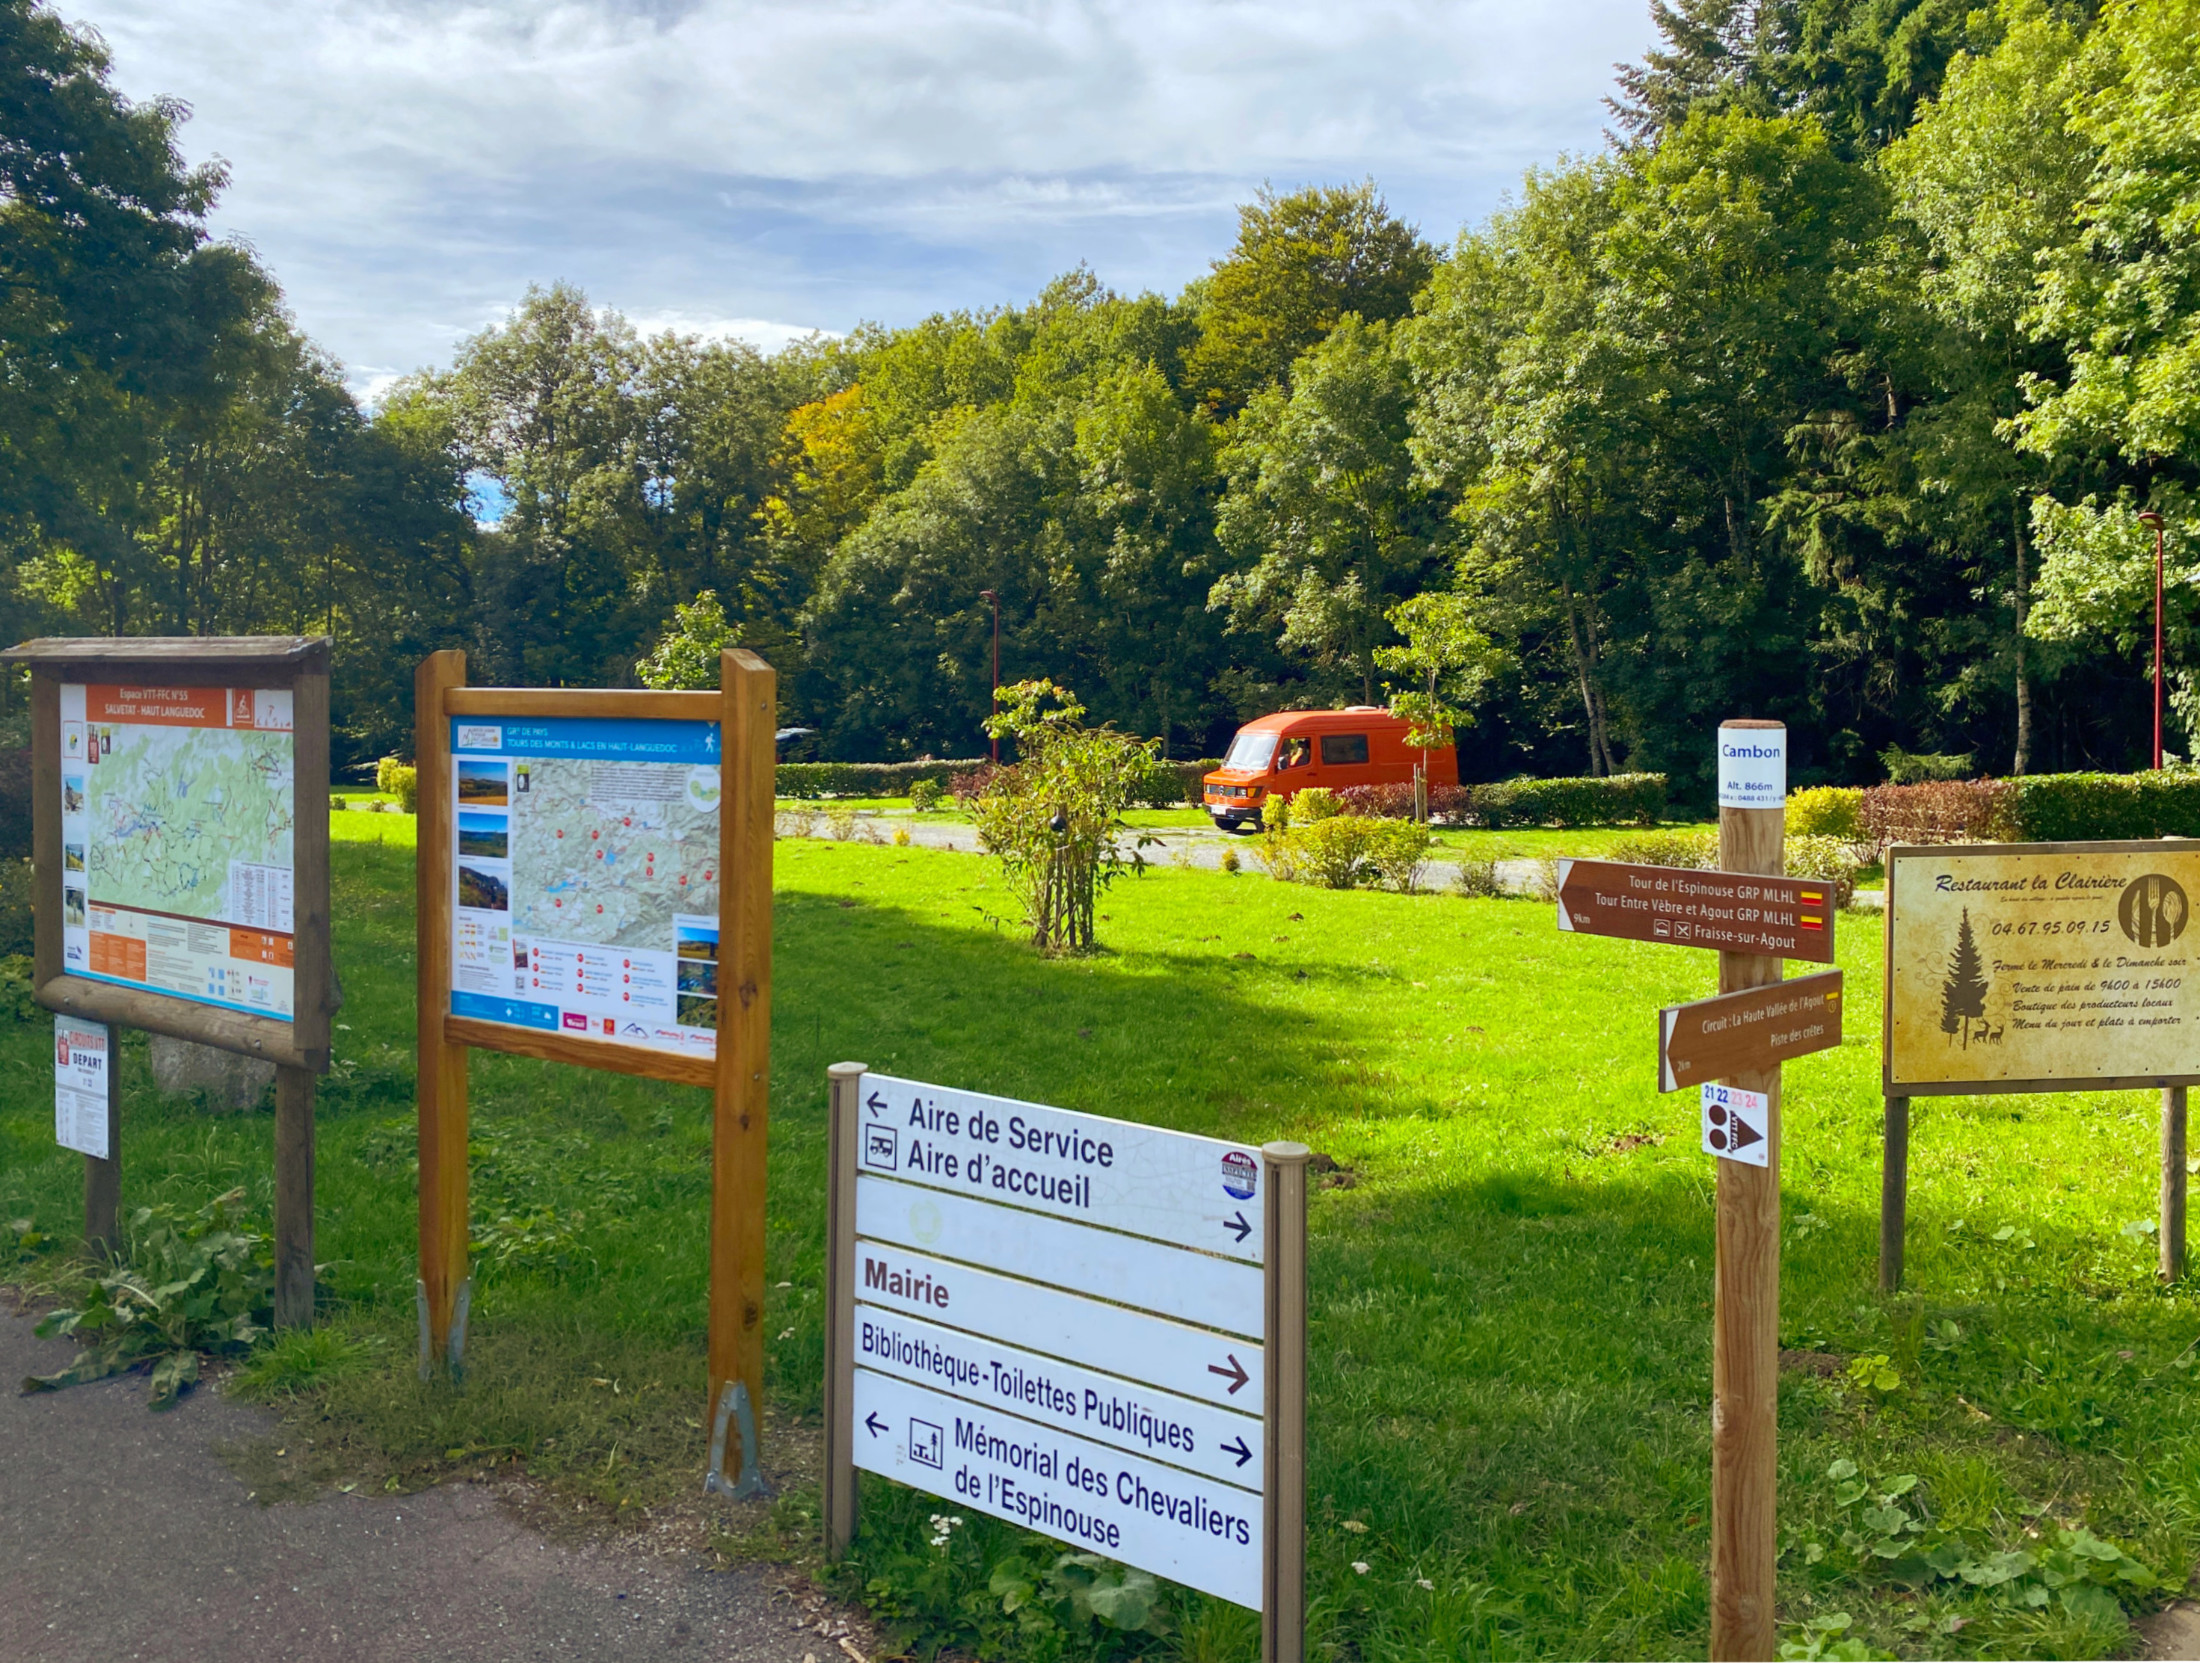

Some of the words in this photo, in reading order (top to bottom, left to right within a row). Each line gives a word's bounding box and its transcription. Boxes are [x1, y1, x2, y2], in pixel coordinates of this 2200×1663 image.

[120, 688, 142, 701] Espace
[143, 688, 171, 700] VTT-FFC
[105, 703, 136, 715] SALVETAT
[141, 705, 160, 717] HAUT
[160, 706, 205, 719] LANGUEDOC
[522, 727, 532, 736] DE
[533, 727, 548, 736] PAYS
[507, 738, 529, 748] TOURS
[530, 739, 543, 748] DES
[545, 740, 569, 749] MONTS
[577, 741, 595, 750] LACS
[597, 741, 607, 750] EN
[608, 742, 678, 753] HAUT-LANGUEDOC
[1723, 744, 1780, 758] Cambon
[1727, 781, 1742, 790] Alt.
[1745, 782, 1773, 791] 866m
[1629, 875, 1652, 889] Tour
[1655, 878, 1668, 891] de
[1671, 879, 1734, 898] l'Espinouse
[1737, 886, 1760, 900] GRP
[1763, 888, 1796, 904] MLHL
[1935, 874, 2028, 892] Restaurant
[2031, 875, 2048, 891] la
[2055, 871, 2127, 890] Clairière
[1595, 892, 1618, 906] Tour
[1621, 895, 1649, 910] Entre
[1651, 898, 1683, 914] Vèbre
[1685, 904, 1697, 915] et
[1700, 904, 1734, 920] Agout
[1737, 908, 1760, 922] GRP
[1763, 910, 1796, 926] MLHL
[1573, 913, 1590, 924] 9km
[1695, 924, 1796, 949] Fraisse-sur-Agout
[1992, 920, 2111, 936] 04.67.95.09.15
[1992, 959, 2025, 973] Fermé
[2027, 959, 2037, 970] le
[2042, 958, 2088, 970] Mercredi
[2091, 958, 2099, 968] &
[2103, 958, 2112, 968] le
[2117, 956, 2165, 968] Dimanche
[2168, 957, 2186, 967] soir
[2012, 982, 2040, 993] Vente
[2044, 982, 2055, 992] de
[2057, 982, 2080, 994] pain
[2084, 982, 2095, 991] de
[2100, 980, 2130, 991] 9h00
[2133, 981, 2139, 990] à
[2145, 978, 2181, 989] 15h00
[1702, 1016, 1728, 1034] Circuit
[1732, 1013, 1742, 1026] La
[1743, 1009, 1765, 1024] Haute
[1766, 1002, 1788, 1018] Vallée
[1788, 1000, 1798, 1012] de
[1799, 994, 1824, 1012] l'Agout
[2012, 1000, 2057, 1014] Boutique
[2060, 999, 2076, 1009] des
[2079, 999, 2138, 1012] producteurs
[2142, 998, 2173, 1008] locaux
[2012, 1018, 2041, 1030] Menu
[2045, 1018, 2057, 1028] du
[2060, 1018, 2082, 1031] jour
[2085, 1017, 2095, 1027] et
[2098, 1016, 2124, 1029] plats
[2127, 1017, 2134, 1026] à
[2138, 1016, 2181, 1028] emporter
[1770, 1033, 1788, 1047] Piste
[1789, 1029, 1802, 1042] des
[1803, 1024, 1824, 1040] crêtes
[73, 1053, 102, 1071] DEPART
[1677, 1060, 1691, 1072] 2km
[1705, 1085, 1714, 1100] 21
[1717, 1088, 1728, 1103] 22
[1731, 1090, 1742, 1105] 23
[1745, 1094, 1758, 1108] 24
[909, 1098, 960, 1135] Aire
[968, 1110, 999, 1143] de
[1009, 1116, 1114, 1168] Service
[907, 1140, 958, 1178] Aire
[967, 1153, 1089, 1208] d’accueil
[865, 1257, 949, 1308] Mairie
[1084, 1388, 1195, 1452] Publiques
[955, 1417, 1058, 1481] Mémorial
[1066, 1456, 1108, 1497] des
[1116, 1471, 1250, 1546] Chevaliers
[955, 1464, 981, 1499] de
[989, 1473, 1120, 1548] l’Espinouse
